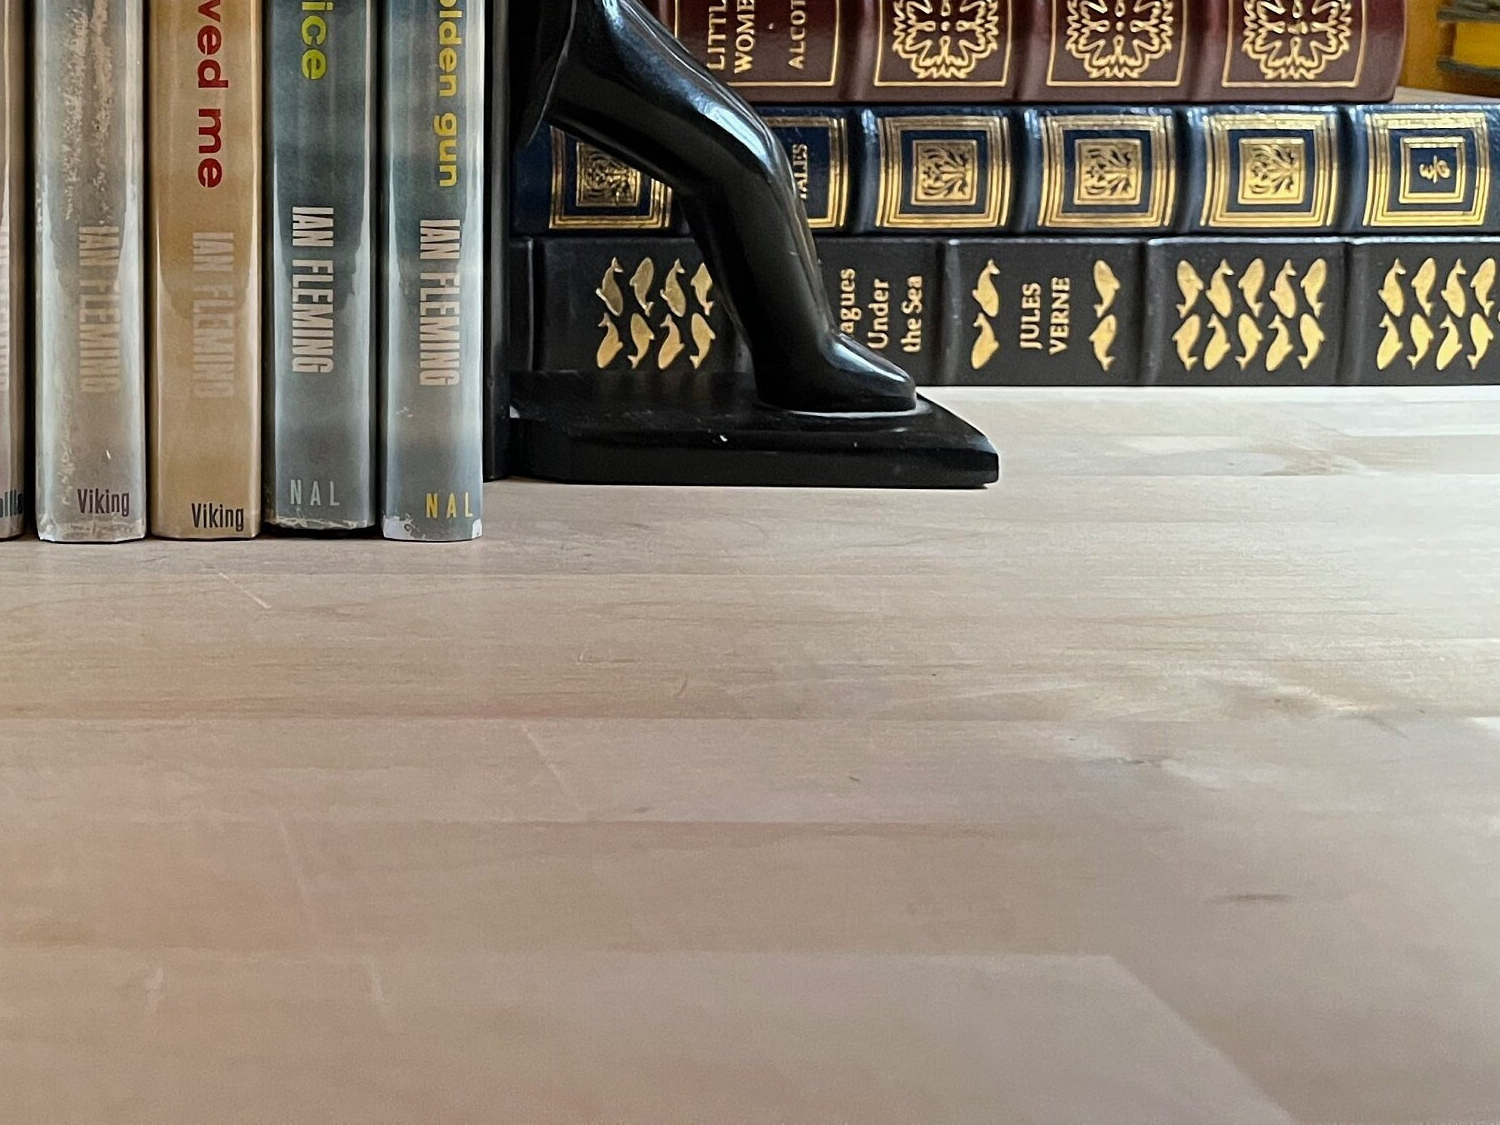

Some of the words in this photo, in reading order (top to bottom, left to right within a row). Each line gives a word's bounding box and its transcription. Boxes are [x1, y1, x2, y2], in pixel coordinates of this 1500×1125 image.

[198, 108, 222, 189] me
[433, 113, 458, 188] gun
[78, 226, 120, 266] IAN
[193, 232, 234, 272] IAN
[292, 207, 334, 247] IAN
[420, 220, 460, 260] IAN
[292, 259, 334, 373] FLEMING
[867, 278, 890, 350] Under
[901, 275, 923, 313] Sea
[1020, 282, 1043, 350] JULES
[1049, 276, 1071, 355] VERNE
[80, 279, 120, 393] FLEMING
[193, 285, 235, 398] FLEMING
[420, 273, 460, 385] FLEMING
[901, 318, 923, 354] the
[77, 488, 130, 517] Viking
[191, 503, 244, 531] Viking
